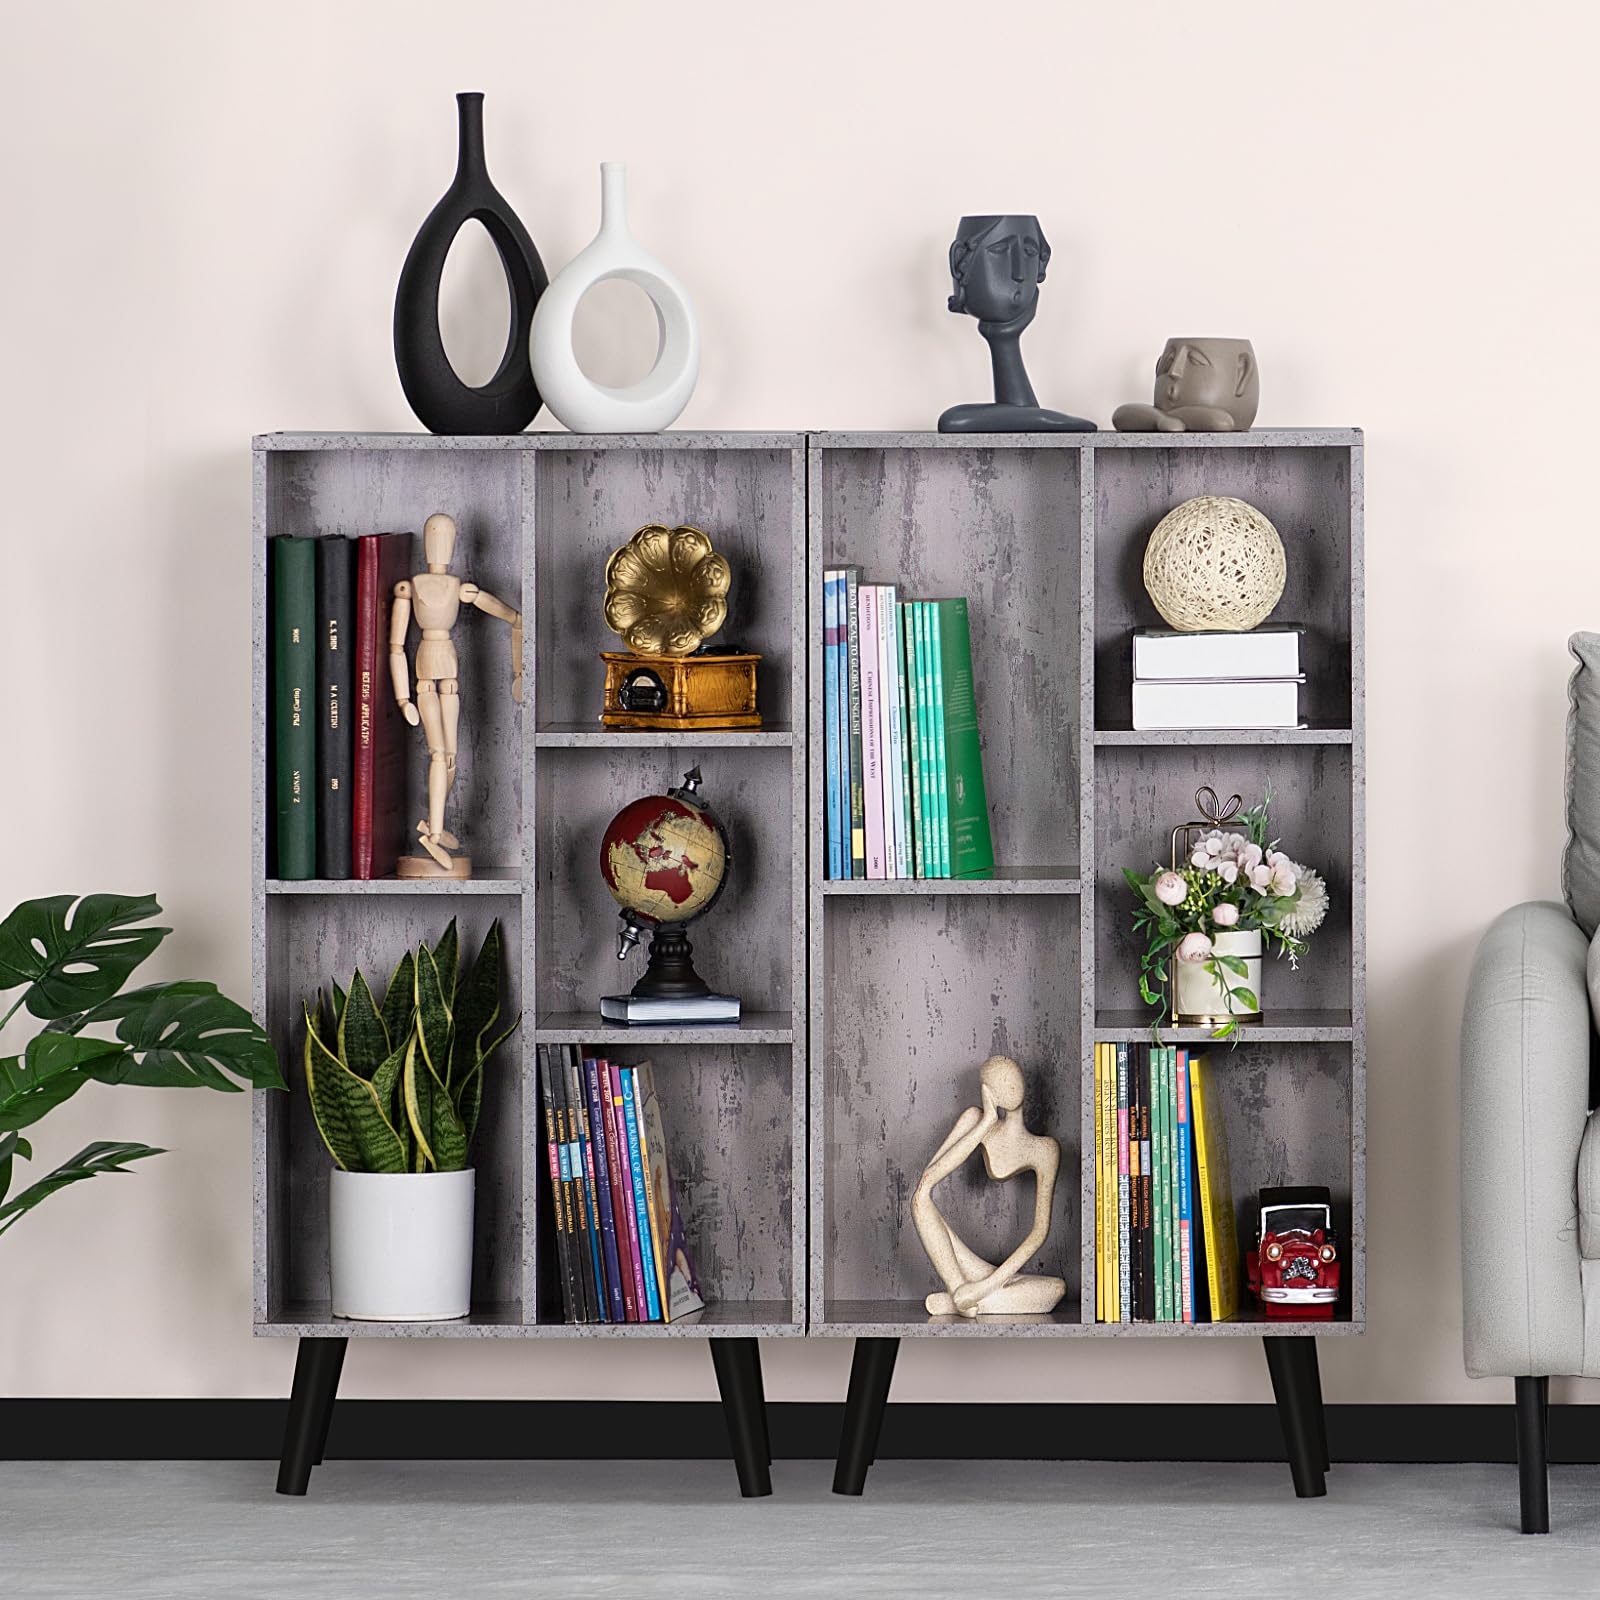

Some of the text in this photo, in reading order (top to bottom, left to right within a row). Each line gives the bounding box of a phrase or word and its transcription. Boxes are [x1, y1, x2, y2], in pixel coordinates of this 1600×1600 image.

[849, 584, 861, 736] FROM LOCAL TO GLOBAL ENGLISH
[626, 1103, 634, 1119] THE
[628, 1123, 638, 1159] JOURNAL
[633, 1162, 640, 1173] OF
[634, 1176, 643, 1195] ASIA
[553, 1179, 563, 1230] ENGLISH AUSTRALIA
[578, 1202, 586, 1230] AUSTRALIA
[591, 1202, 599, 1230] AUSTRALIA
[637, 1199, 646, 1216] TEFL
[565, 1205, 573, 1233] AUSTRALIA
[1181, 1229, 1191, 1312] ENGLISH WORLD-WIDE
